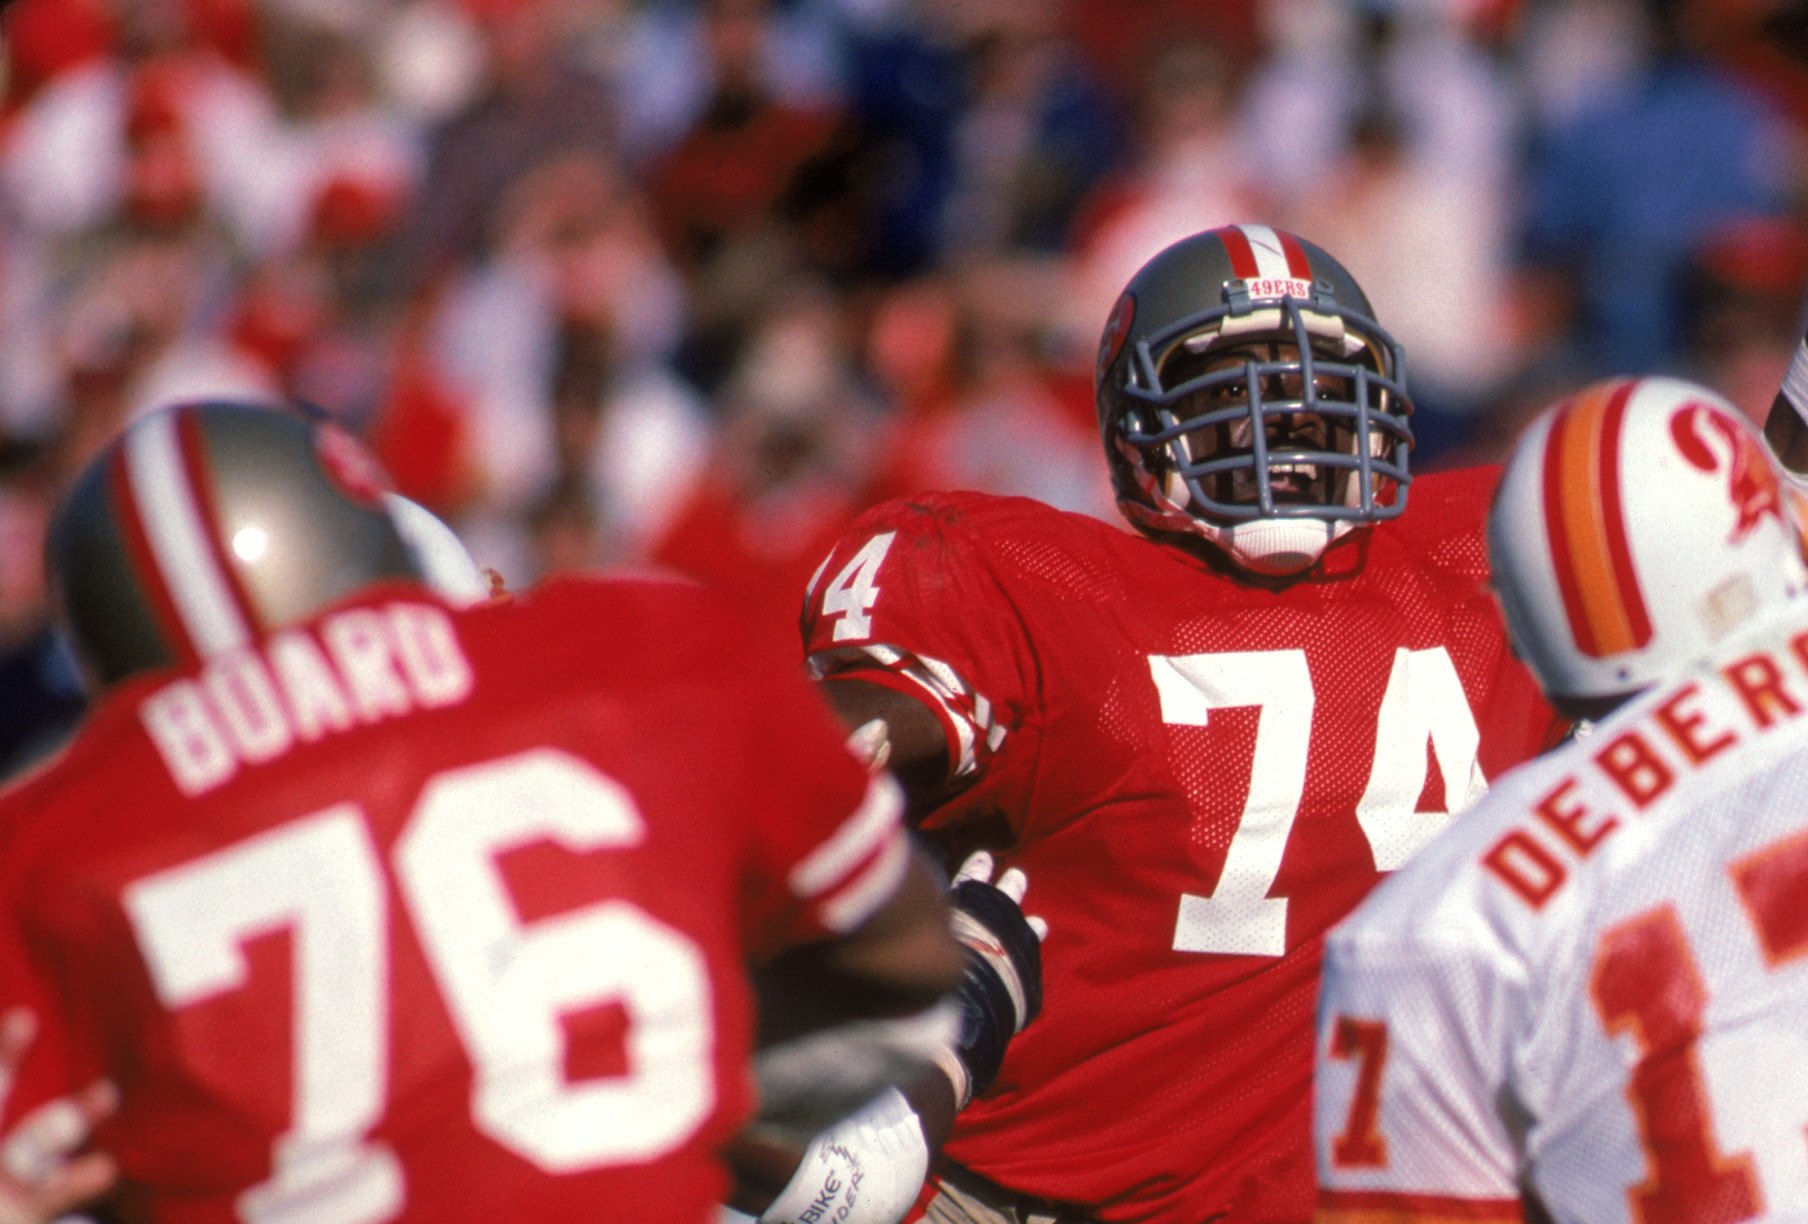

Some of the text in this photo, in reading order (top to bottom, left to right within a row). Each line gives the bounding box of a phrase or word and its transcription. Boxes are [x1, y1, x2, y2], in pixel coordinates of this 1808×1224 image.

[1251, 280, 1306, 297] 49ERS
[140, 602, 475, 797] BOARD
[1148, 645, 1490, 957] 74
